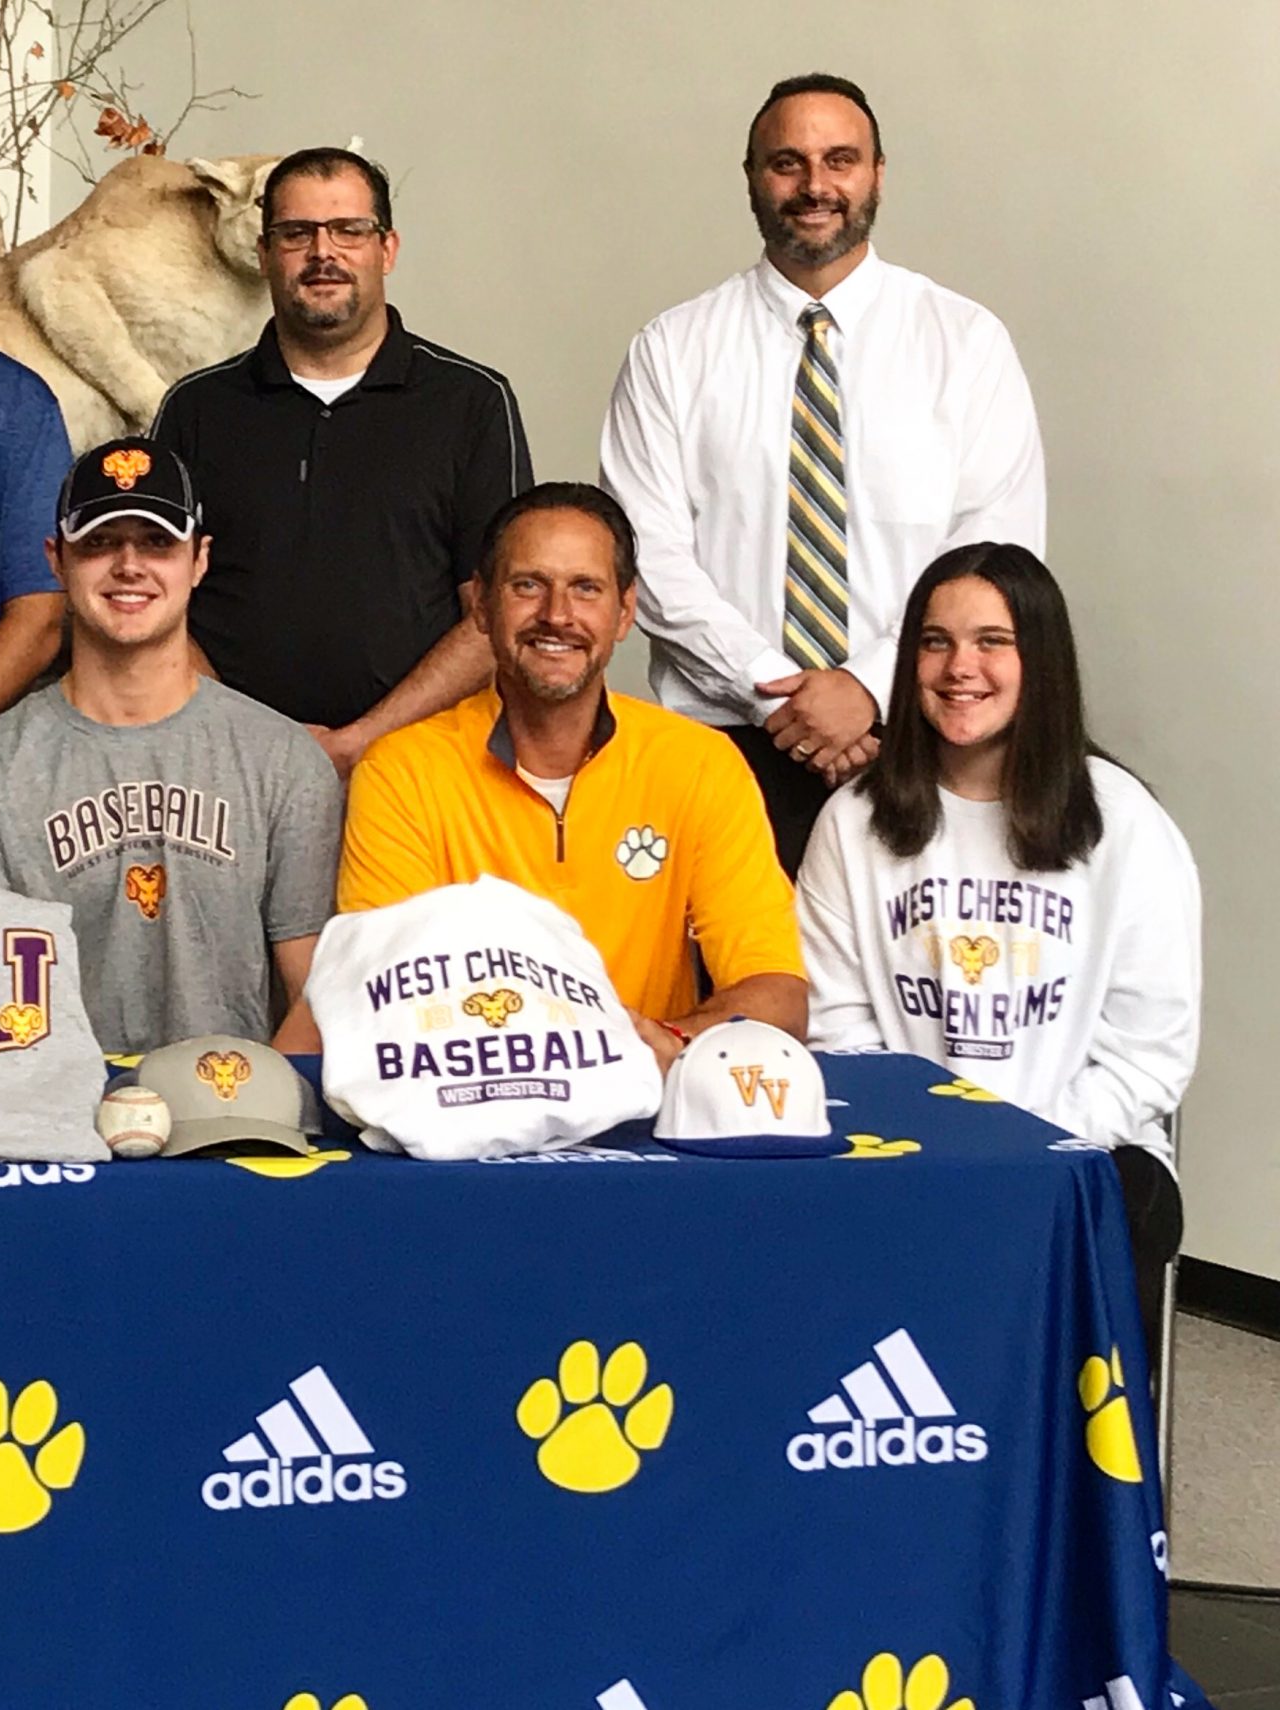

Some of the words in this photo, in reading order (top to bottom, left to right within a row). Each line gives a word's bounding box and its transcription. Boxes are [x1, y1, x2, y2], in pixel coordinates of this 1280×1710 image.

[45, 781, 236, 872] BASEBALL
[886, 877, 948, 940] WEST
[958, 877, 1073, 944] CHESTER
[366, 955, 451, 1012] WEST
[465, 948, 606, 1013] CHESTER
[376, 1029, 623, 1080] BASEBALL
[441, 1085, 483, 1104] WEST
[786, 1416, 988, 1472] adidas
[201, 1453, 407, 1511] adidas
